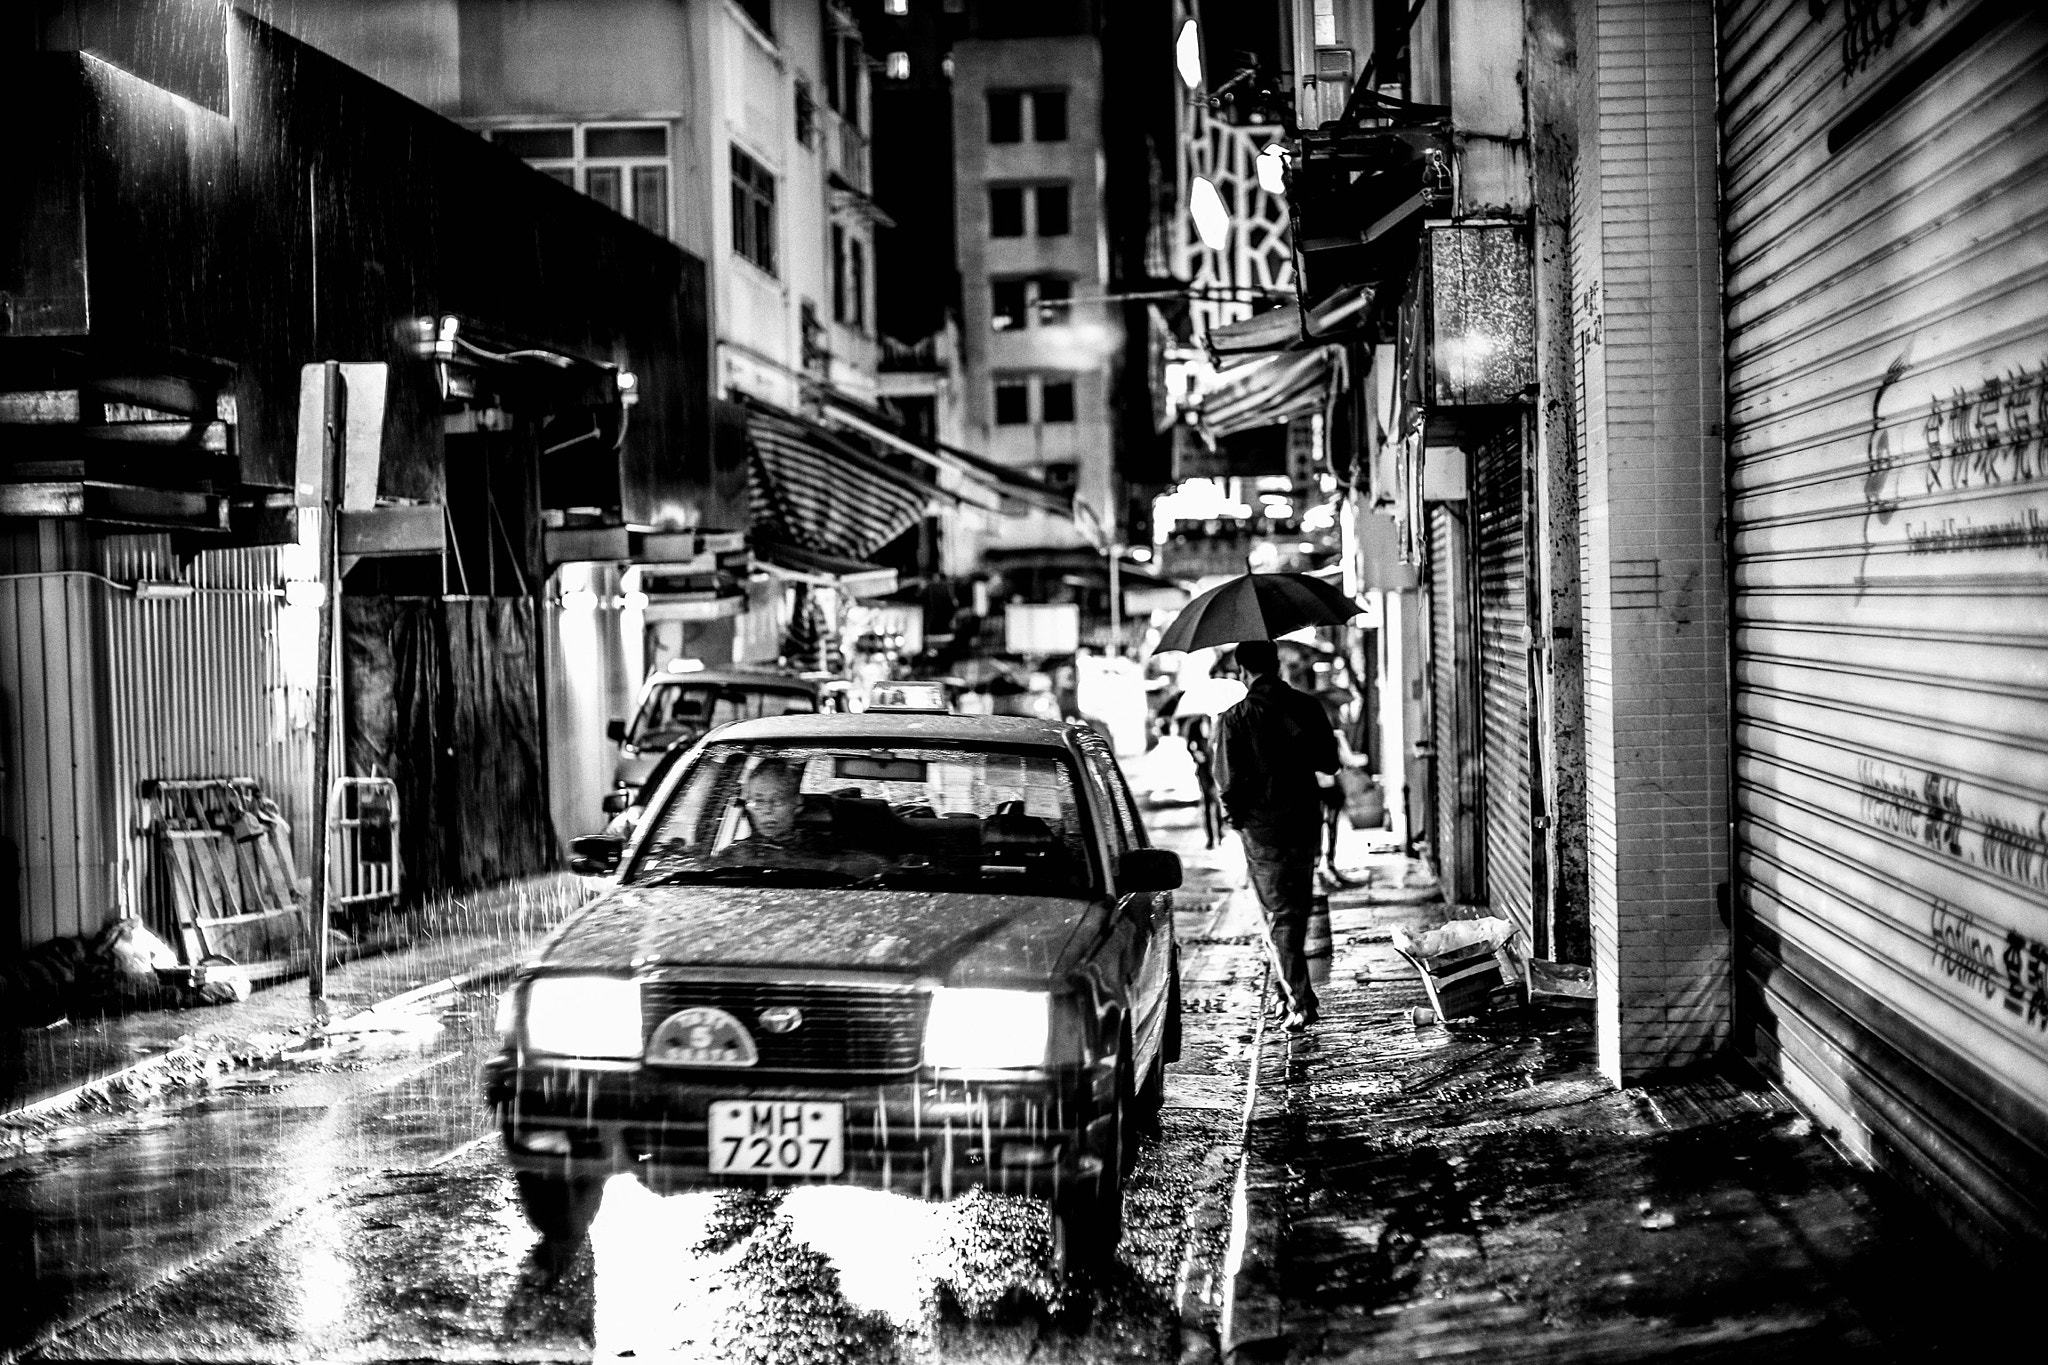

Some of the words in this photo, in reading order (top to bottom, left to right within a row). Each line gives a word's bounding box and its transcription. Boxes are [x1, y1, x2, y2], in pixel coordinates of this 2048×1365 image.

[1857, 758, 1919, 839] Website
[1931, 898, 1997, 1000] Hotline
[690, 1025, 714, 1049] 5
[749, 1104, 804, 1137] MH
[720, 1135, 831, 1171] 7207
